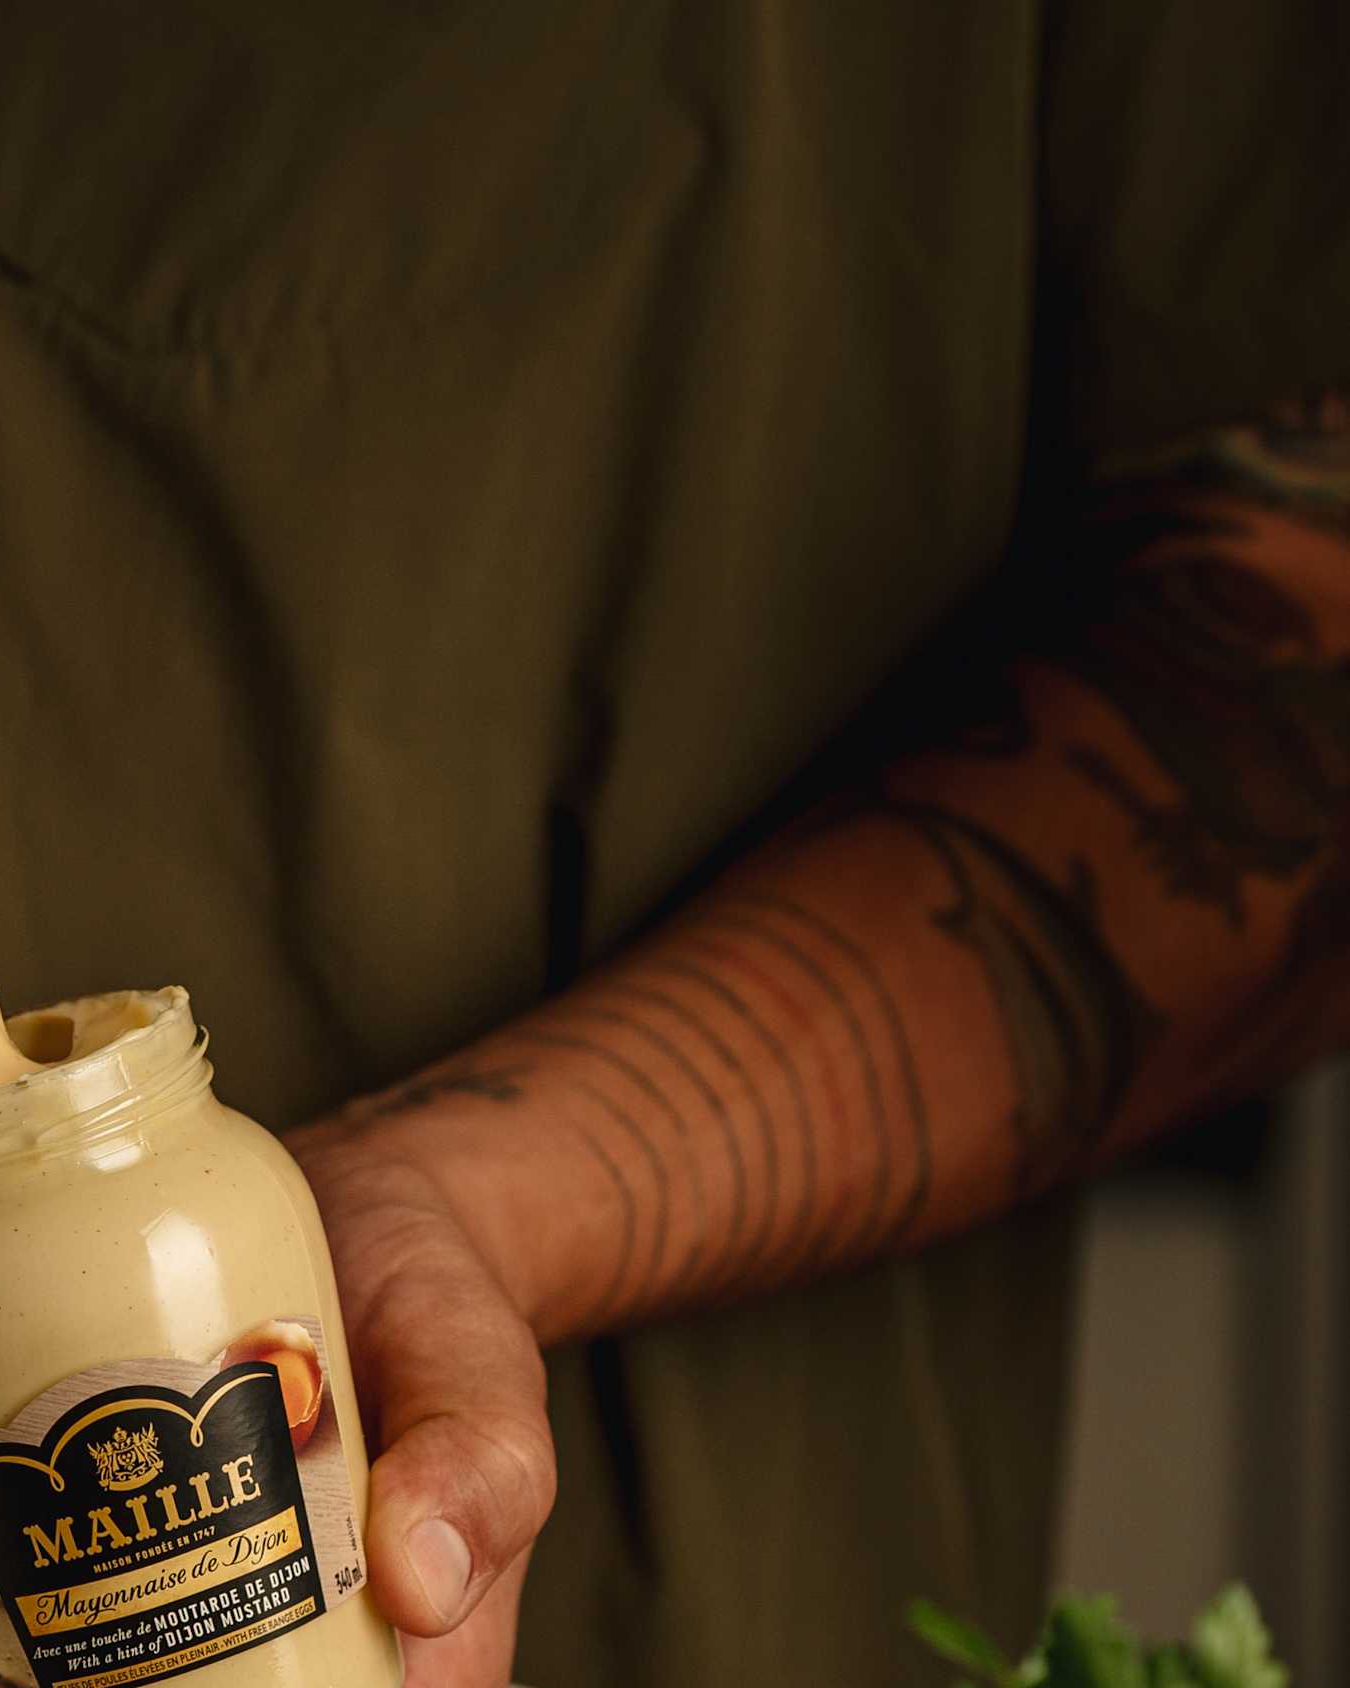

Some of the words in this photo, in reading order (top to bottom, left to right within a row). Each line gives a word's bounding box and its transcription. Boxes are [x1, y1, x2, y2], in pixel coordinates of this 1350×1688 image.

[23, 1454, 262, 1568] MAILLE
[93, 1555, 132, 1574] MAISON
[135, 1539, 174, 1562] FONDÉE
[177, 1535, 191, 1548] EN
[193, 1525, 216, 1542] 1747
[33, 1646, 62, 1660] Avec
[64, 1640, 88, 1654] une
[91, 1628, 133, 1648] touche
[136, 1621, 152, 1636] de
[154, 1588, 241, 1632] MOUTARDE
[245, 1579, 265, 1598] DE
[269, 1556, 311, 1589] DIJON
[36, 1568, 187, 1626] Mayonnaise
[191, 1550, 220, 1579] de
[221, 1528, 289, 1568] Dijon
[68, 1653, 101, 1672] With
[104, 1653, 113, 1664] a
[117, 1643, 145, 1661] hint
[148, 1635, 164, 1655] of
[164, 1618, 216, 1648] DIJON
[220, 1587, 291, 1628] MUSTARD
[95, 1671, 129, 1687] POULES
[166, 1656, 179, 1669] EN
[180, 1648, 204, 1664] PLEIN
[204, 1642, 220, 1656] AIR
[223, 1633, 248, 1648] WITH
[249, 1625, 267, 1641] FREE
[268, 1613, 294, 1631] RANGE
[294, 1601, 314, 1619] EGGS
